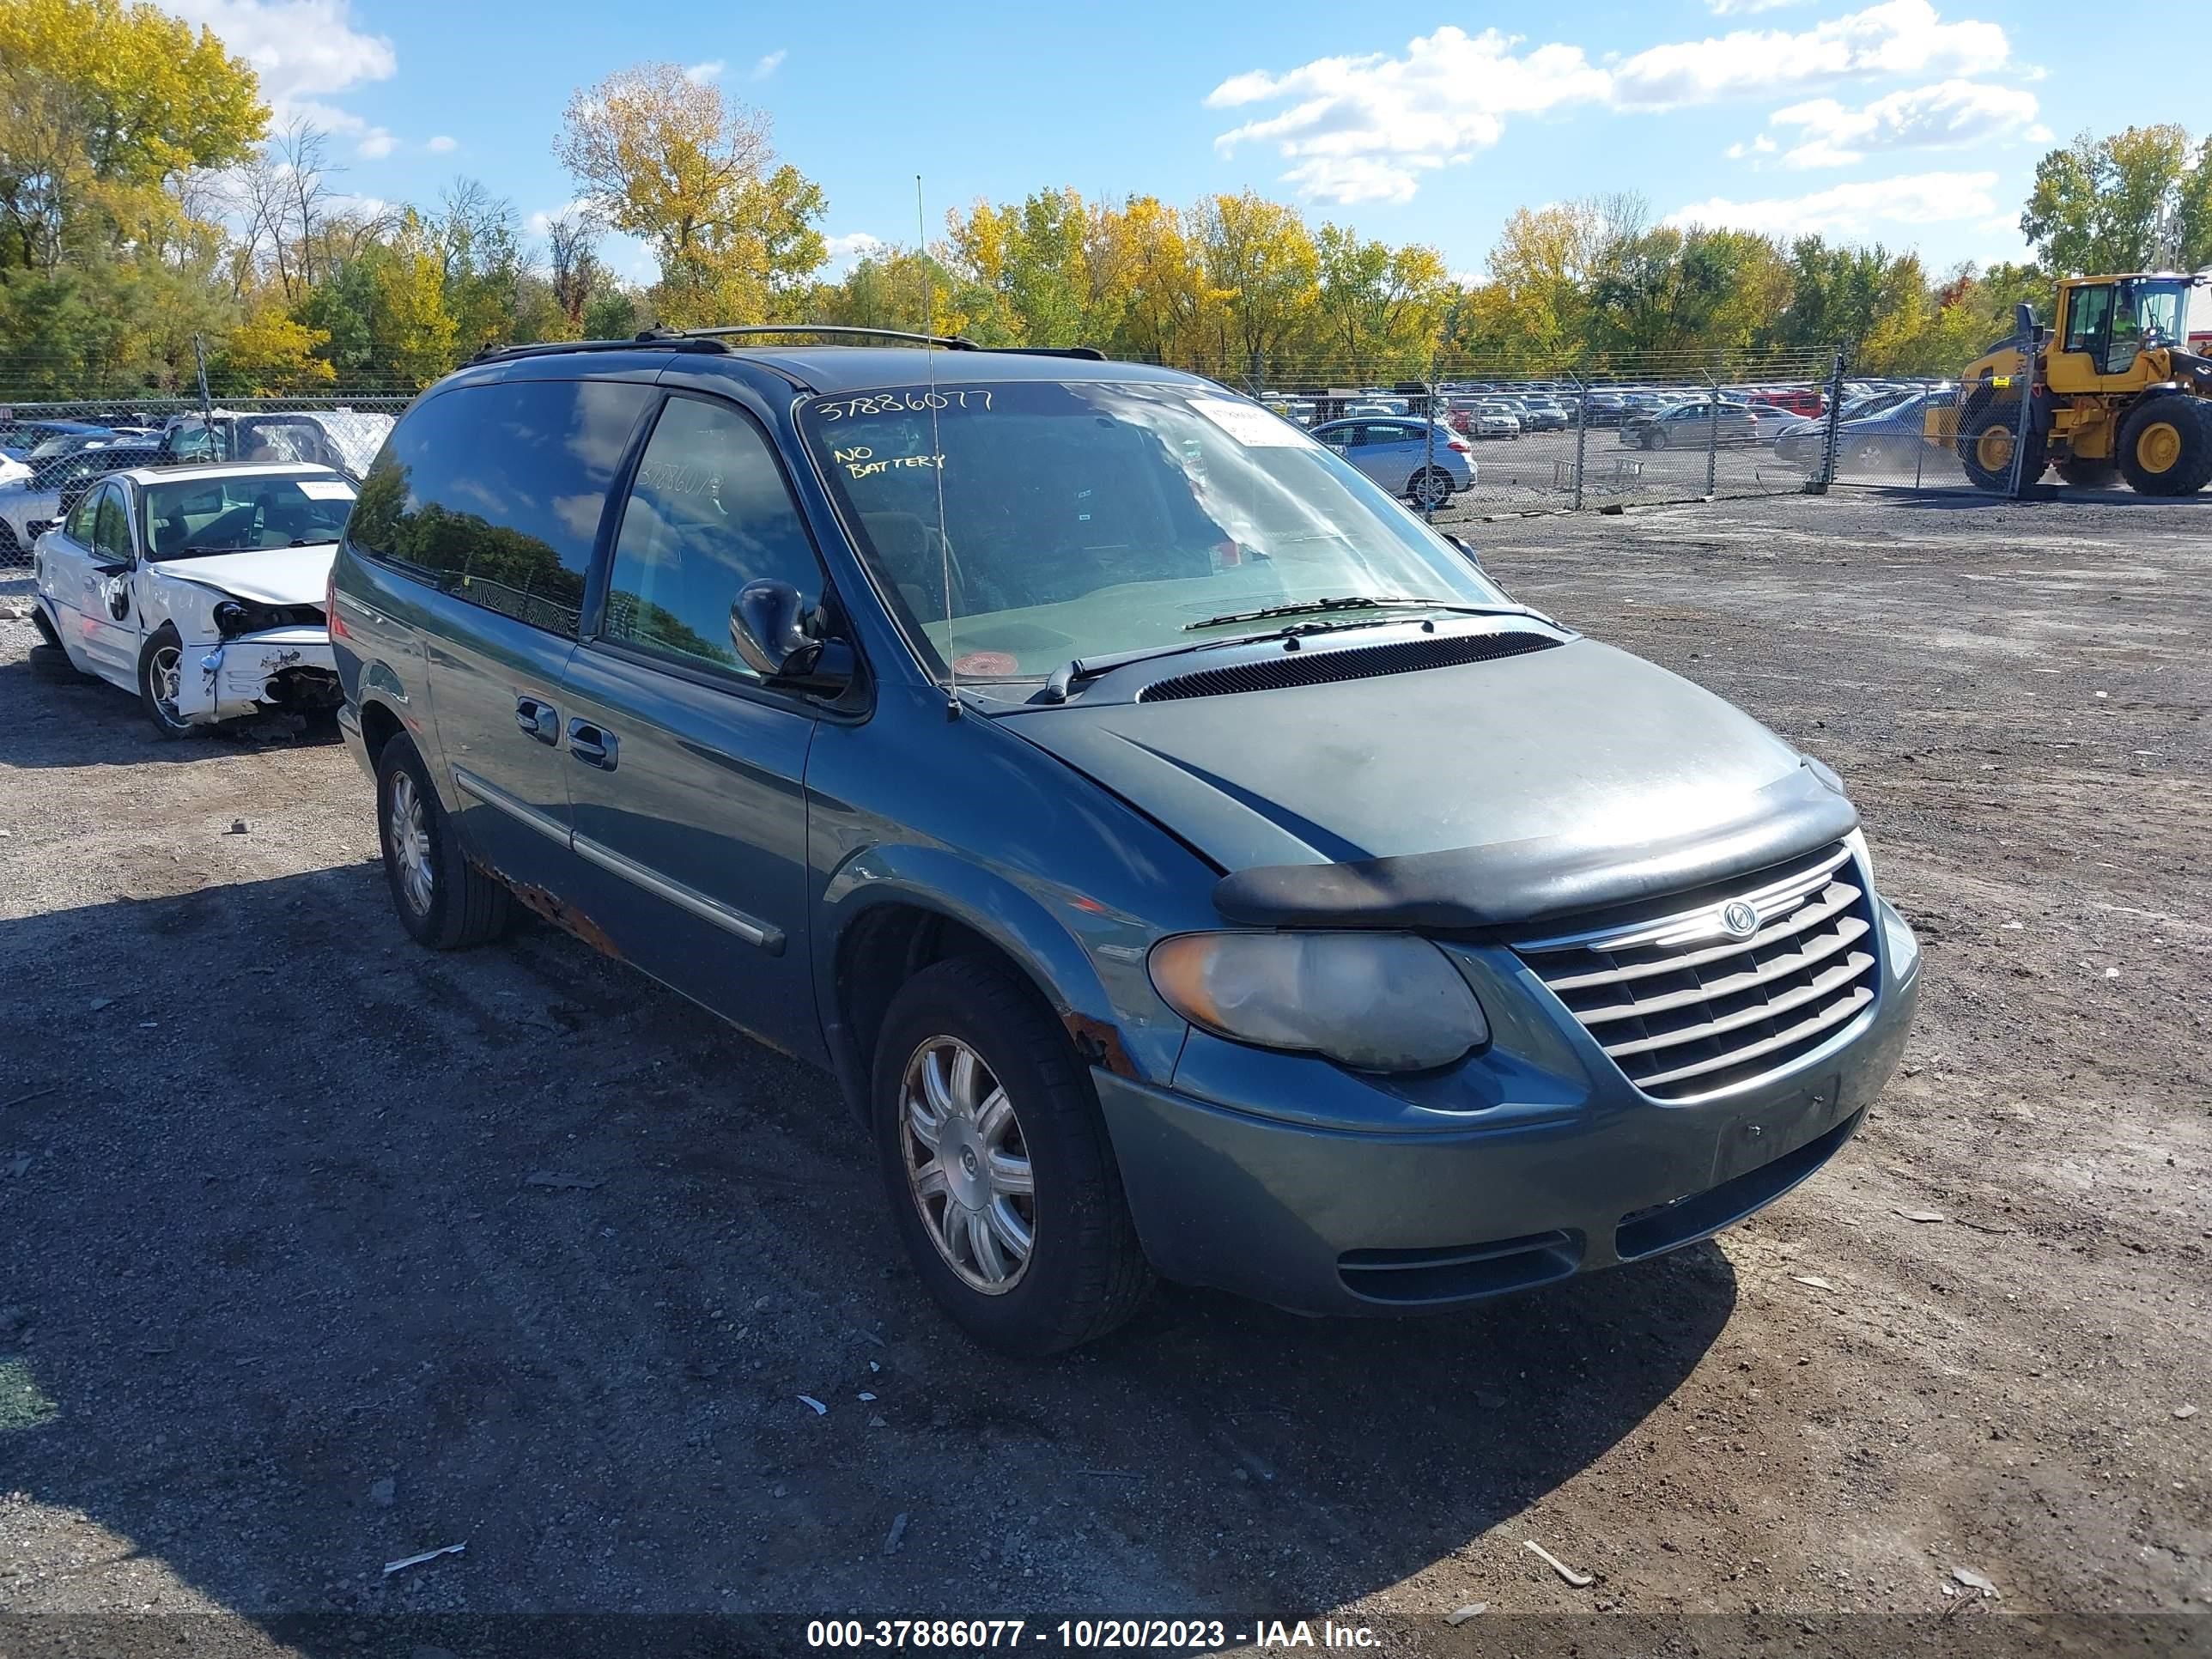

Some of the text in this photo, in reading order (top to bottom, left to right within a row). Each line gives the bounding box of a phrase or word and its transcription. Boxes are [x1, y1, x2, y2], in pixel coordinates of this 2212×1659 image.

[815, 390, 993, 422] 37886077
[833, 447, 872, 465] NO
[845, 453, 946, 480] BATTERY
